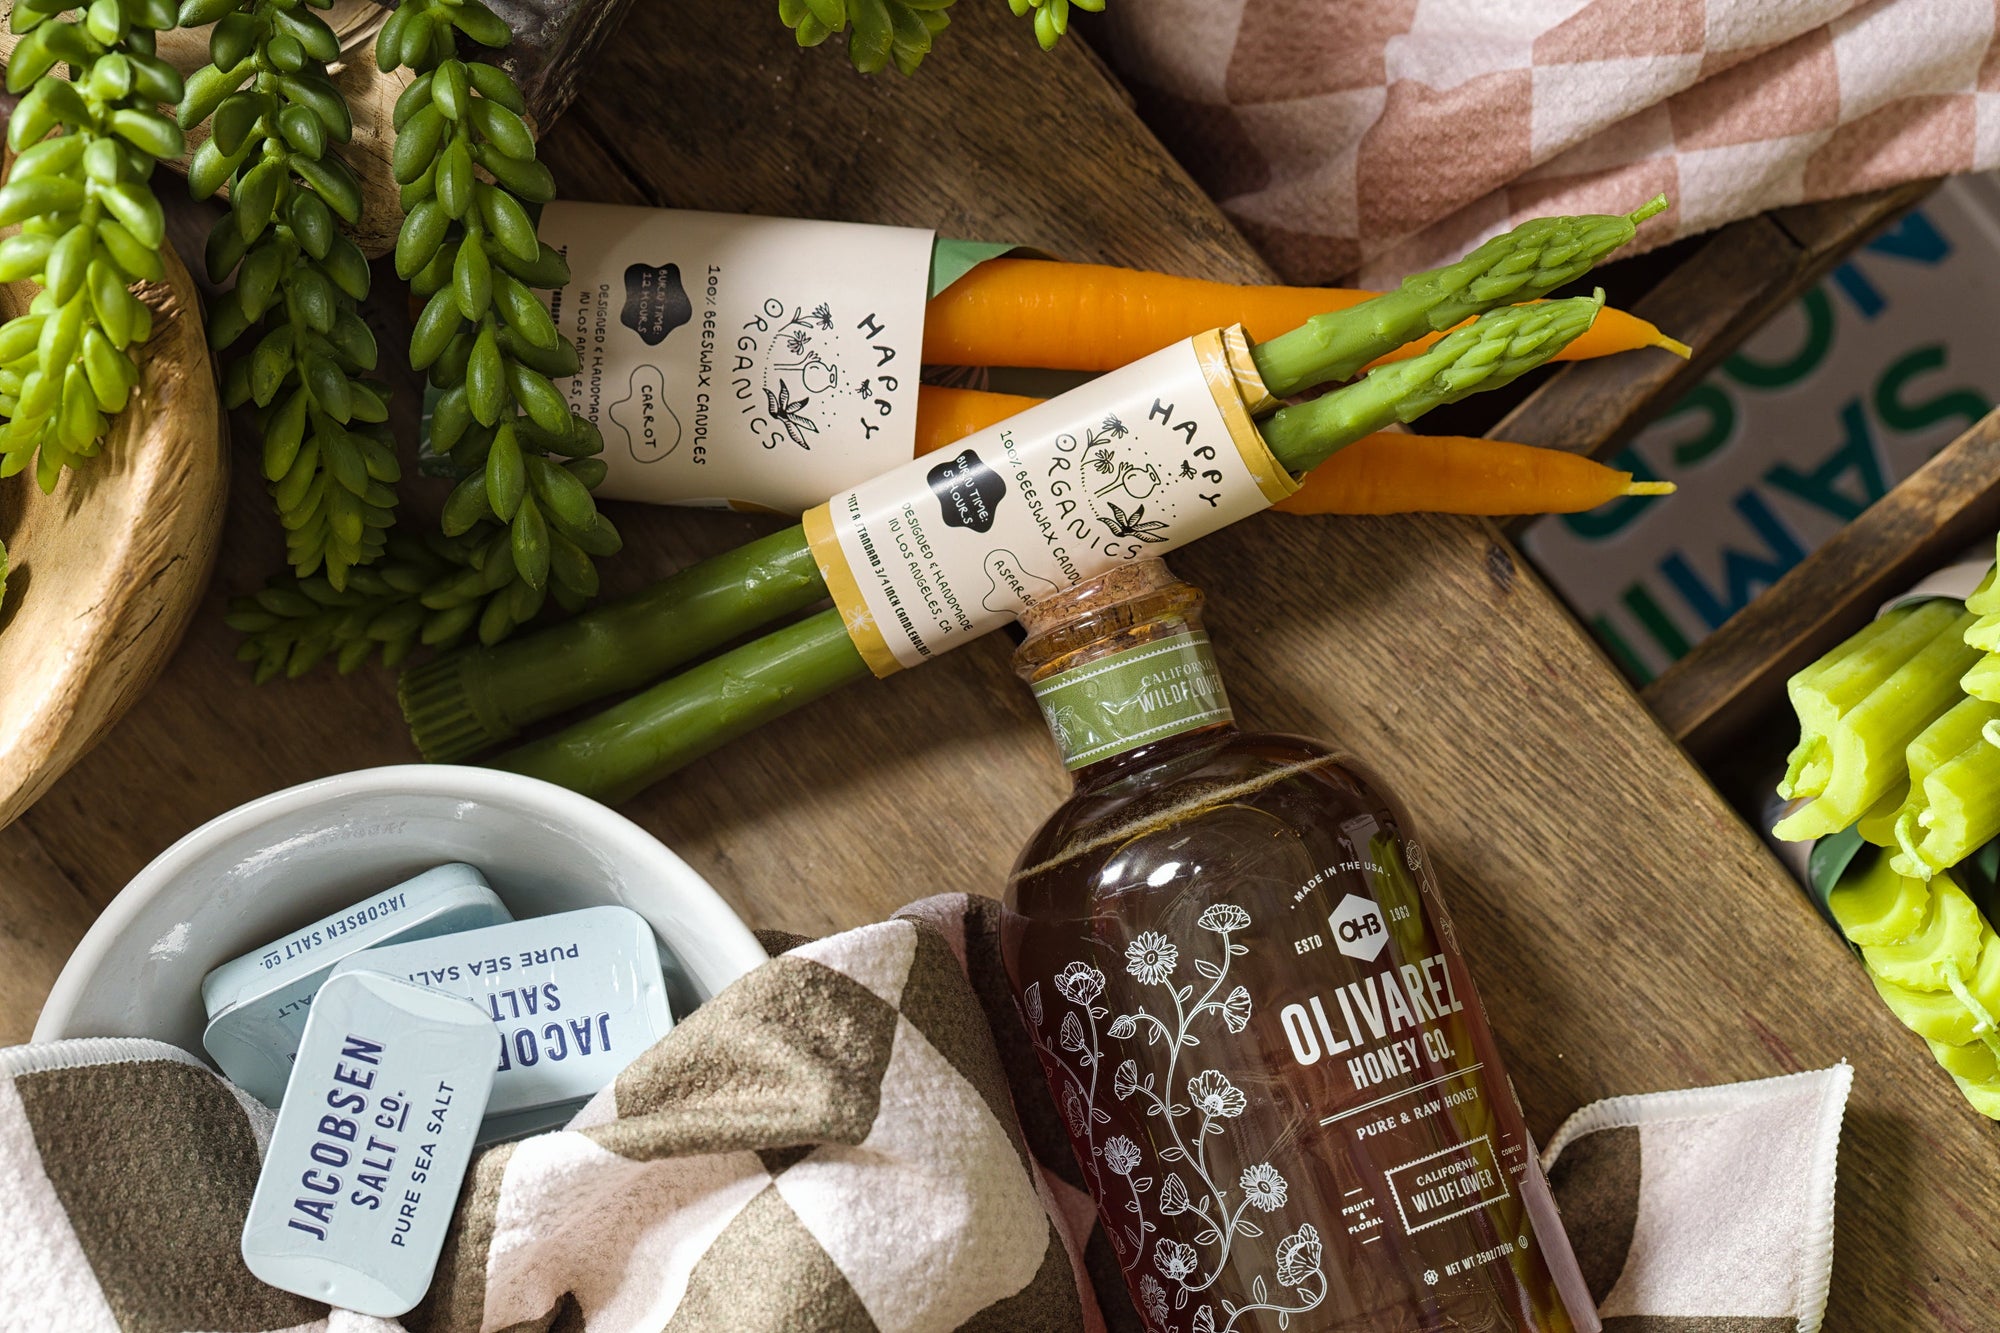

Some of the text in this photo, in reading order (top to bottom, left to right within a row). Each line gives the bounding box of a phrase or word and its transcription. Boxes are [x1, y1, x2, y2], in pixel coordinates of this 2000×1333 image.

[576, 308, 589, 334] LOS
[579, 291, 591, 304] IN
[594, 283, 610, 344] DESIGNED
[637, 272, 653, 334] 12 HOURS
[652, 269, 668, 336] BURN TIME:
[692, 264, 721, 466] 100% BEESWAX CANDLES
[732, 297, 785, 450] ORGANICS
[857, 312, 899, 440] HAPPY
[640, 384, 657, 449] CARROT
[1149, 397, 1223, 508] HAPPY
[943, 469, 974, 525] 5 HOURS
[956, 455, 989, 523] BURN TIME:
[1000, 430, 1022, 468] 100%
[1016, 470, 1059, 546] BEESWAX
[1048, 433, 1143, 559] ORGANICS
[874, 567, 891, 586] 3/4
[883, 586, 901, 607] INCH
[888, 517, 953, 634] IN LOS ANGELES, CA
[901, 502, 934, 560] DESIGNED
[932, 570, 974, 632] HANDMADE
[993, 560, 1039, 607] ASPARAG
[1137, 674, 1222, 714] WILDFLOWE
[1293, 860, 1385, 902] MADE IN THE USA
[260, 892, 407, 970] JACOBSEN SALT CO.
[519, 943, 579, 968] PURE
[1293, 905, 1410, 955] ESTD OHB 1963
[468, 956, 512, 977] SEA
[278, 990, 318, 1019] ALT
[487, 981, 562, 1022] SALT
[1280, 953, 1464, 1066] OLIVAREZ
[1346, 1028, 1456, 1090] HONEY CO.
[287, 1032, 387, 1242] JACOBSEN
[1356, 1086, 1480, 1141] PURE & RAW HONEY
[350, 1090, 412, 1211] SALT CO.
[391, 1080, 455, 1247] PURE SEA SALT
[1416, 1156, 1480, 1187] CALIFORNIA
[1341, 1197, 1376, 1217] FRUITY
[1360, 1212, 1367, 1220] &
[1411, 1168, 1496, 1214] WILDFLOWER
[1348, 1216, 1384, 1235] FLORAL
[1444, 1262, 1461, 1278] NET
[1461, 1256, 1475, 1271] WT
